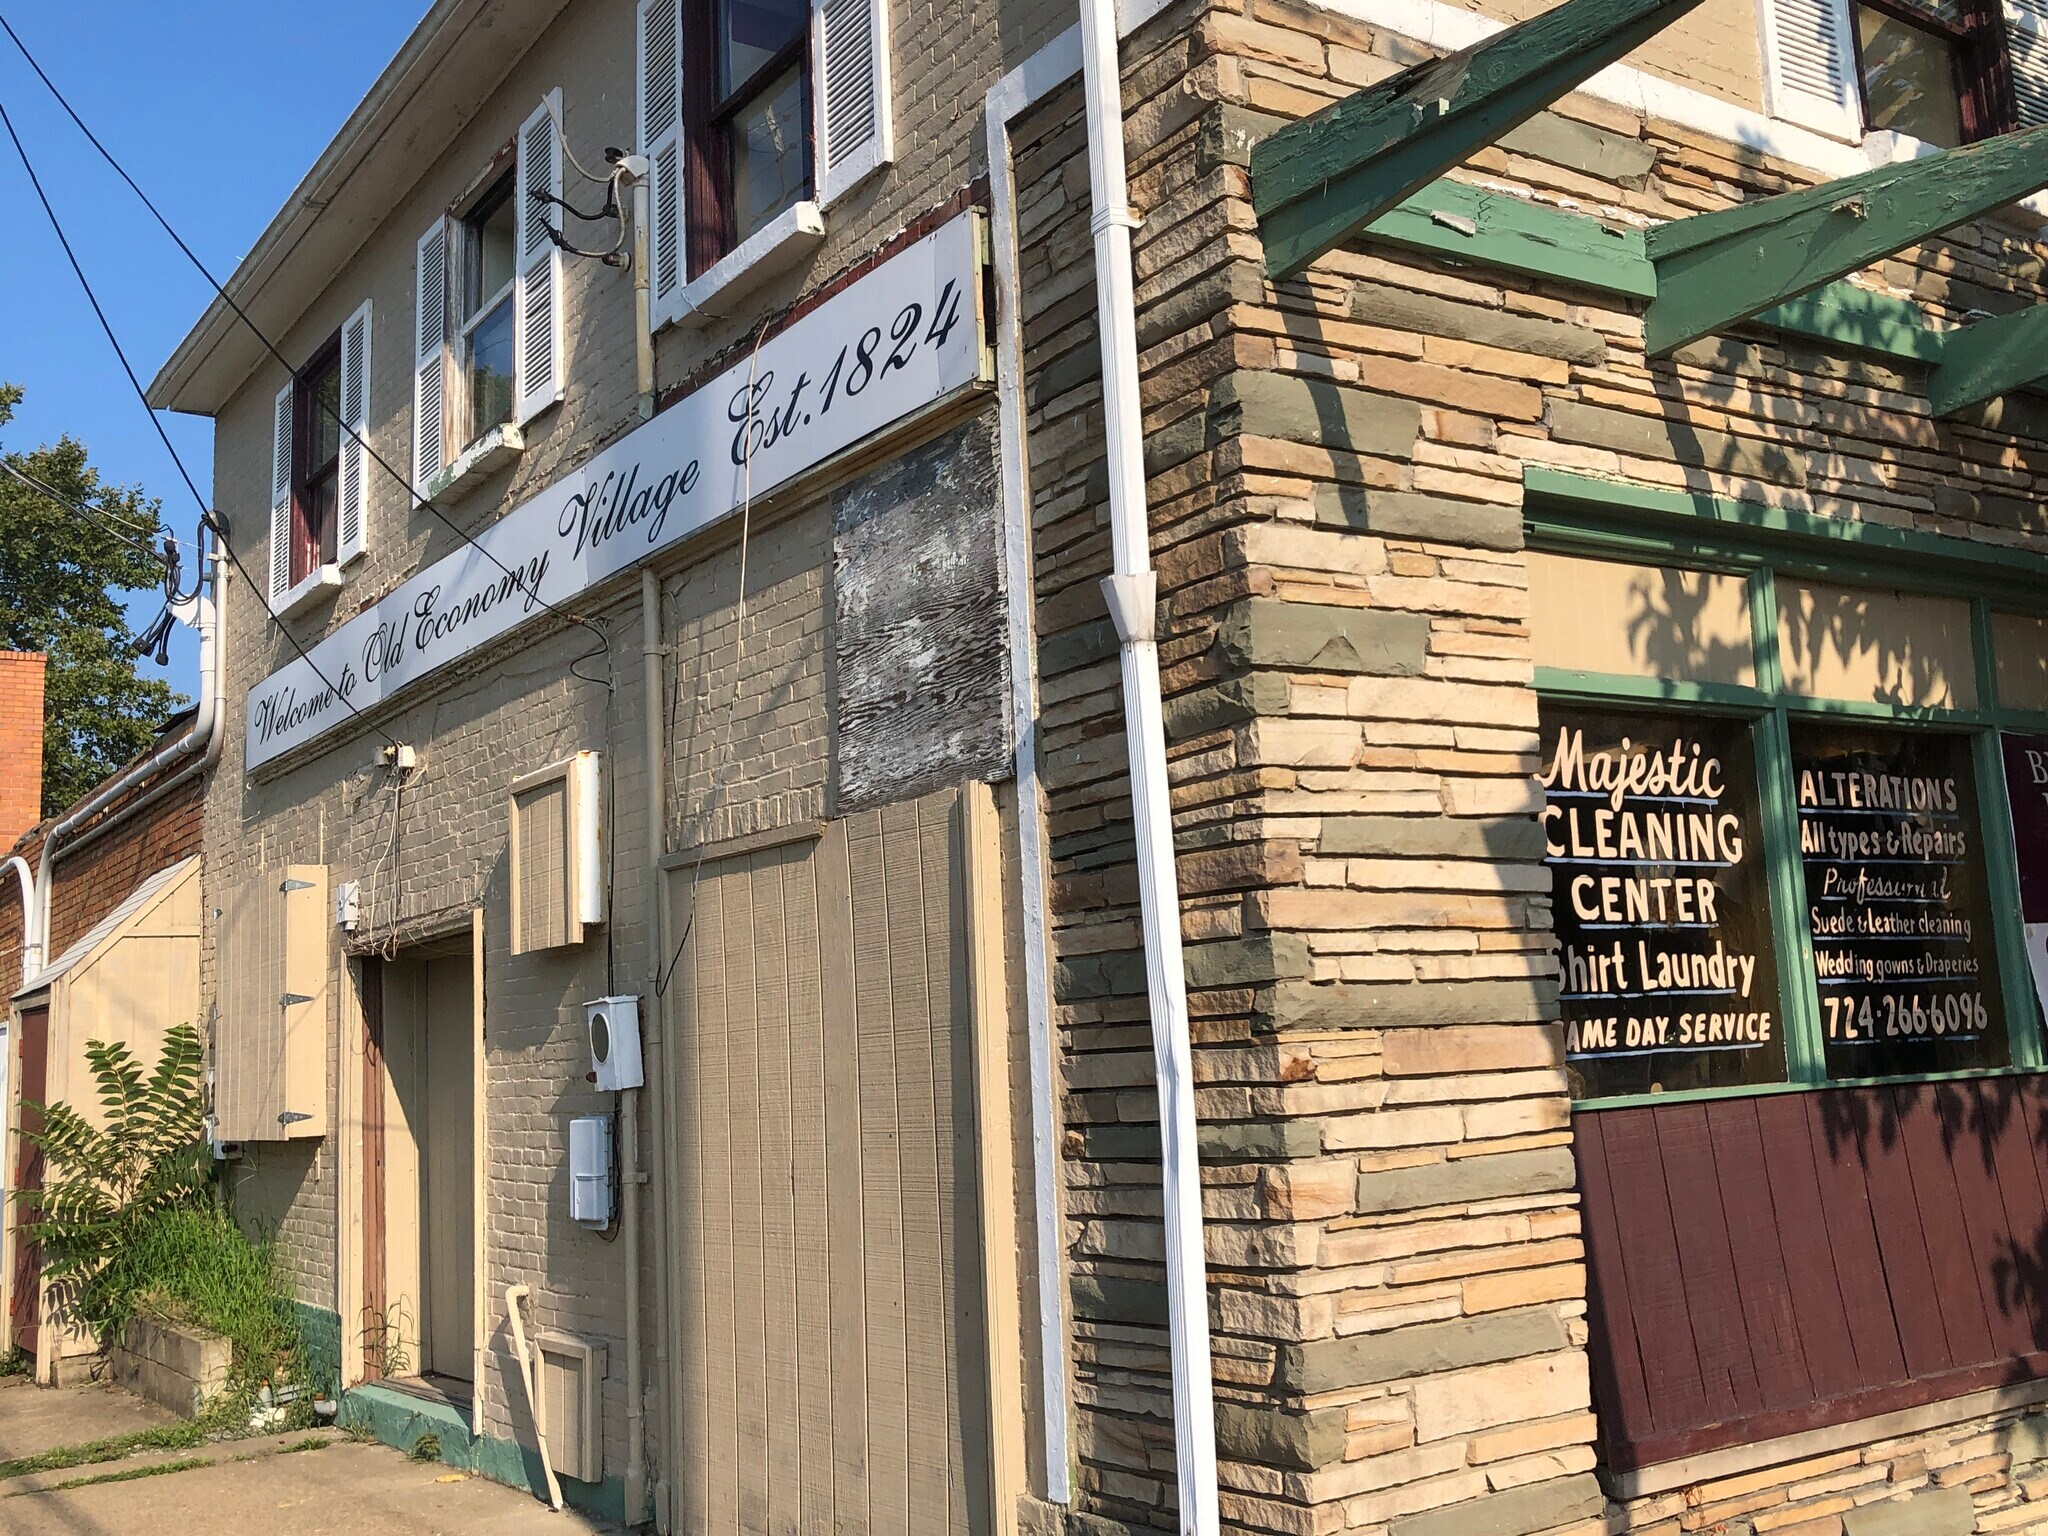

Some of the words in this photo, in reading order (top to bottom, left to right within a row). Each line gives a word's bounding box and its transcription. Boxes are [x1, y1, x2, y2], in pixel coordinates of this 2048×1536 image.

[254, 686, 334, 746] Welcome
[339, 662, 358, 702] to
[361, 612, 409, 683] Old
[414, 548, 550, 654] Economy
[558, 458, 701, 562] Village
[727, 371, 812, 468] Est.
[820, 277, 962, 415] 1824
[1534, 725, 1725, 812] Majestic
[1800, 769, 1957, 812] ALTERATIONS
[1538, 804, 1743, 864] CLEANING
[1801, 819, 1827, 854] All
[1829, 826, 1881, 860] types
[1902, 821, 1967, 861] Repairs
[1570, 874, 1719, 924] CENTER
[1811, 905, 1855, 934] Suede
[1867, 907, 1915, 934] Leather
[1918, 910, 1971, 943] cleaning
[1638, 940, 1756, 999] Laundry
[1815, 950, 1874, 982] Wedding
[1876, 959, 1915, 982] gowns
[1926, 952, 1979, 978] Draperies
[1564, 1017, 1618, 1053] AME
[1625, 1017, 1670, 1048] DAY
[1679, 1012, 1772, 1044] SERVICE
